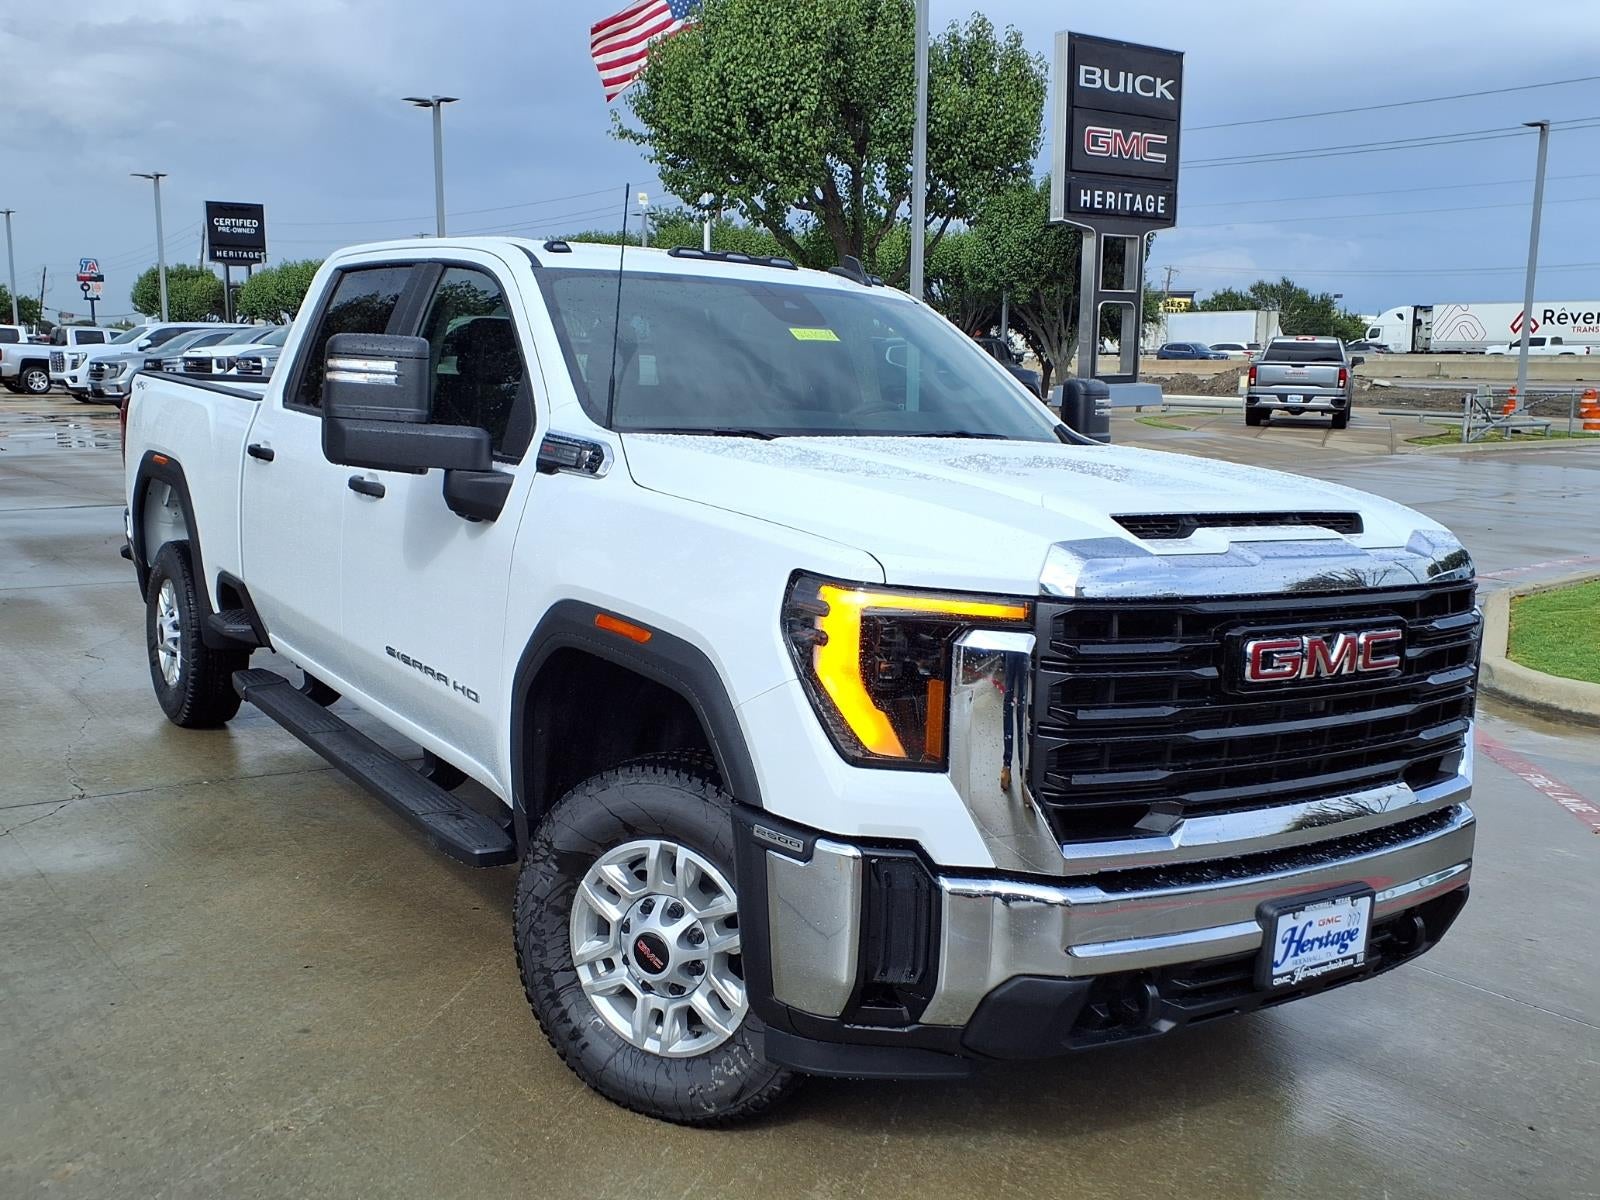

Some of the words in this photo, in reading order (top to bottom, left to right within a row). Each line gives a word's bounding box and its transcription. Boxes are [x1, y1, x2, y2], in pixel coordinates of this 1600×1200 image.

[1079, 65, 1175, 100] BUICK
[1084, 126, 1168, 163] GMC
[1080, 189, 1166, 213] HERITAGE
[213, 217, 259, 228] CERTIFIED
[217, 226, 256, 234] PRE-OWNED
[81, 259, 99, 273] TA
[216, 250, 261, 259] HERITAGE
[1245, 629, 1402, 682] GMC
[385, 645, 449, 687] SIERRA
[453, 680, 480, 703] HD
[752, 824, 804, 853] 2500
[1318, 914, 1342, 927] GMC
[637, 939, 664, 969] GMC
[1273, 920, 1360, 969] Heritage
